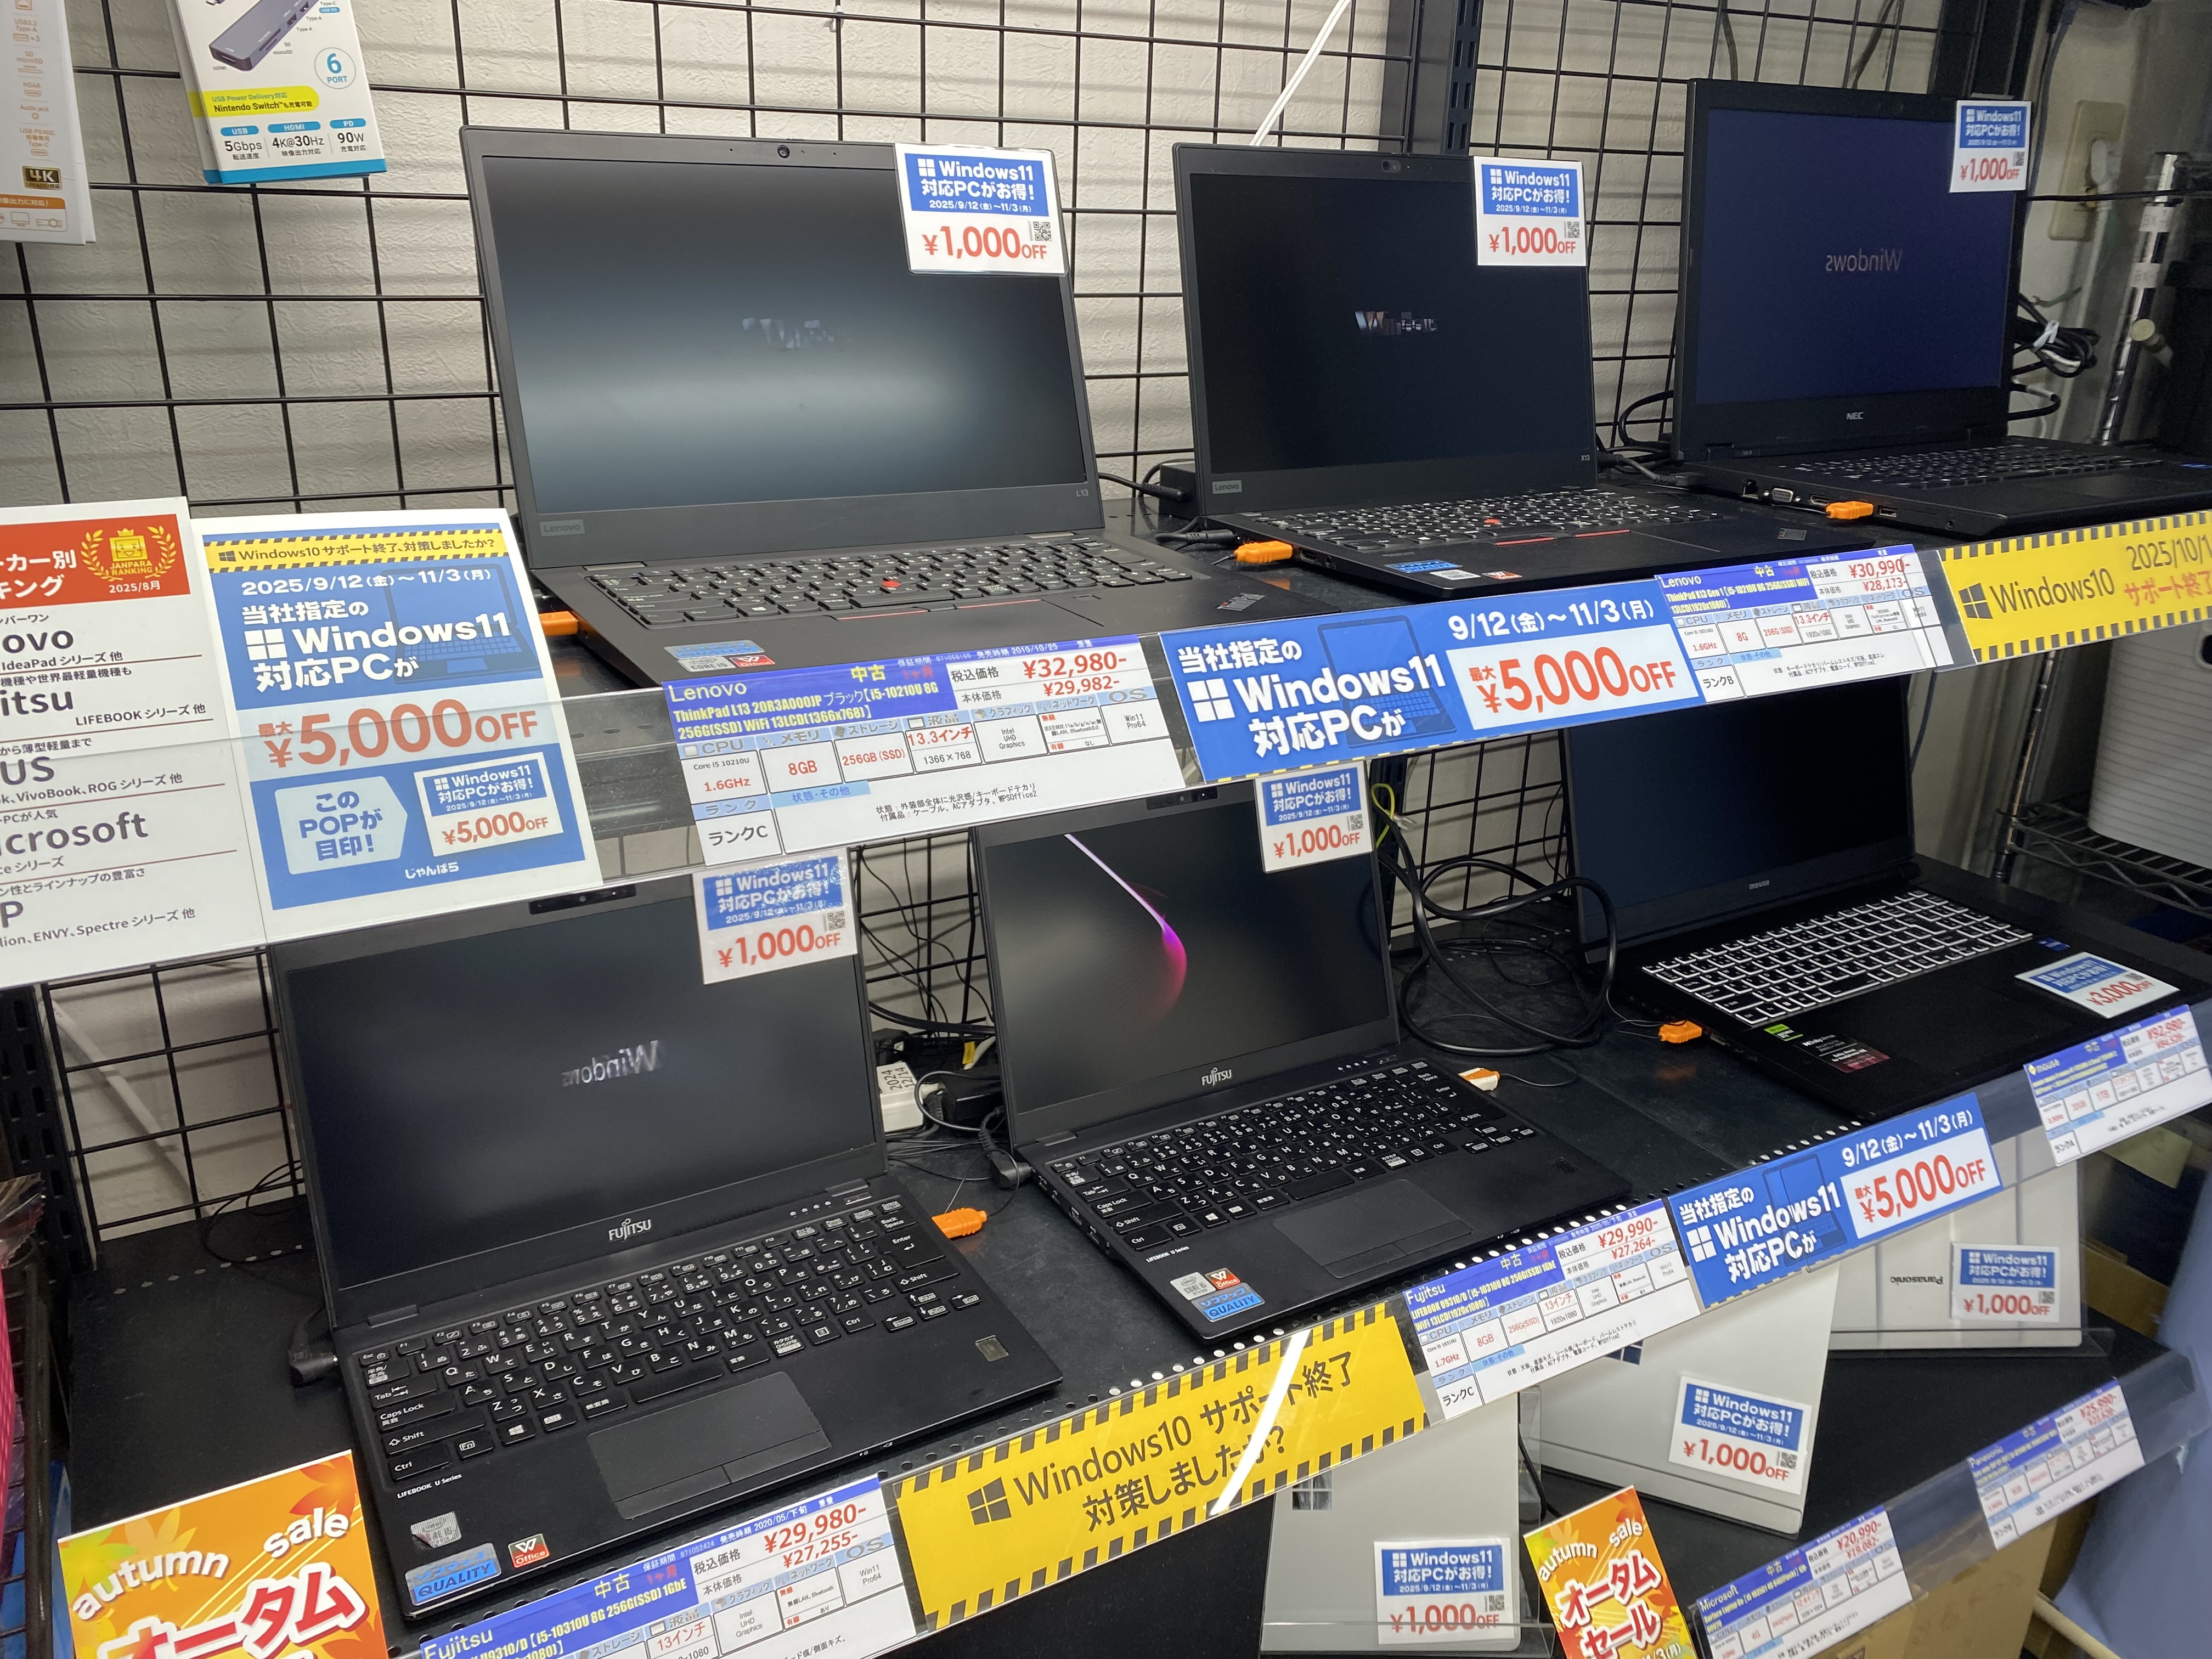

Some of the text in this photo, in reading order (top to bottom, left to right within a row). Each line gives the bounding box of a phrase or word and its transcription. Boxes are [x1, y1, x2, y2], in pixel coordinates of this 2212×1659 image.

[326, 53, 342, 74] 6
[213, 104, 251, 113] Nintendo
[1977, 110, 2022, 121] Windows11
[224, 140, 262, 153] 5Gbps
[272, 135, 325, 149] 4K@30Hz
[337, 132, 364, 143] 90W
[232, 153, 260, 161] 転送速度
[281, 148, 321, 157] 映像出力対応
[29, 169, 55, 182] 4K
[938, 159, 1034, 182] Windows11
[1504, 170, 1570, 187] Windows11
[920, 178, 1035, 201] 対応PCがお得!
[1491, 185, 1570, 204] 対応PCがお得!
[1846, 411, 1864, 420] NEC
[1215, 483, 1240, 492] Lenovo
[543, 524, 580, 533] Lenovo
[238, 538, 495, 561] Windows10 サポート終了、対策しましたか?
[0, 549, 77, 572] カー別
[109, 560, 153, 570] JANPARA
[111, 567, 153, 575] RANKING
[109, 580, 161, 594] 2025/8月
[1660, 575, 1702, 589] Lenovo
[1989, 568, 2115, 613] Windows10
[241, 599, 370, 626] 当社指定の
[291, 611, 512, 655] Windows11
[1736, 632, 1749, 642] 8G
[60, 653, 106, 666] シリーズ
[110, 651, 123, 662] 他
[1177, 637, 1304, 675] 当社指定の
[252, 653, 419, 693] 対応PCが
[850, 664, 887, 683] 中古
[950, 651, 1127, 682] 税込価格 ¥32,980-
[1468, 664, 1497, 684] 最大
[668, 681, 748, 703] Lenovo
[1233, 653, 1448, 715] Windows11
[1702, 676, 1734, 689] ランクB
[75, 703, 206, 726] LIFEBOOK シリーズ 他
[673, 703, 731, 724] ThinkPad
[732, 701, 751, 715] L13
[258, 720, 294, 737] 最大
[781, 729, 820, 745] メモリ
[848, 720, 899, 736] ストレージ
[907, 726, 973, 747] 13.3インチ
[1248, 703, 1406, 760] 対応PCが
[702, 738, 744, 755] CPU
[842, 748, 906, 766] 256GB (SSD)
[450, 764, 531, 787] Windows11
[788, 760, 818, 776] 8GB
[437, 777, 533, 804] 対応PCがお得!
[704, 778, 751, 792] 1.6GHz
[1285, 772, 1351, 795] Windows11
[315, 790, 360, 811] この
[1272, 787, 1351, 812] 対応PCがお得!
[298, 809, 383, 838] POPが
[708, 825, 769, 846] ランクC
[316, 833, 374, 861] 目印!
[736, 862, 829, 892] Windows11
[1748, 879, 1770, 889] mouse
[881, 1069, 903, 1091] 2024
[1201, 1068, 1232, 1086] FUJITSU
[1678, 1186, 1755, 1226] 当社指定の
[1714, 1181, 1841, 1250] Windows11
[608, 1218, 652, 1242] FUJITSU
[891, 1234, 912, 1245] Enter
[1500, 1253, 1523, 1271] 中古
[1724, 1229, 1816, 1285] 対応PCが
[1983, 1252, 2047, 1266] Windows11
[1891, 1275, 1943, 1285] Panasonic
[1405, 1284, 1446, 1305] Fujitsu
[1209, 1294, 1255, 1317] QUALITY
[1477, 1334, 1494, 1347] 8GB
[1435, 1353, 1460, 1368] 1.7GHz
[374, 1391, 391, 1401] Tab
[1442, 1386, 1474, 1405] ランクC
[380, 1402, 424, 1422] Caps Lock
[1712, 1392, 1793, 1424] Windows11
[1693, 1403, 1790, 1437] 対応PCがお得!
[402, 1430, 425, 1443] Shift
[1013, 1415, 1192, 1507] Windows10
[397, 1483, 432, 1499] LIFEBOOK
[1410, 1549, 1493, 1567] Windows11
[1538, 1517, 1644, 1583] autumn sale
[72, 1506, 349, 1621] autumn sale
[417, 1562, 492, 1598] QUALITY
[1393, 1565, 1492, 1583] 対応PCがお得!
[594, 1572, 631, 1599] 中古
[1554, 1549, 1662, 1629] オータム
[1701, 1584, 1739, 1612] Microsoft
[1580, 1599, 1662, 1659] セール
[423, 1629, 493, 1659] Fujitsu
